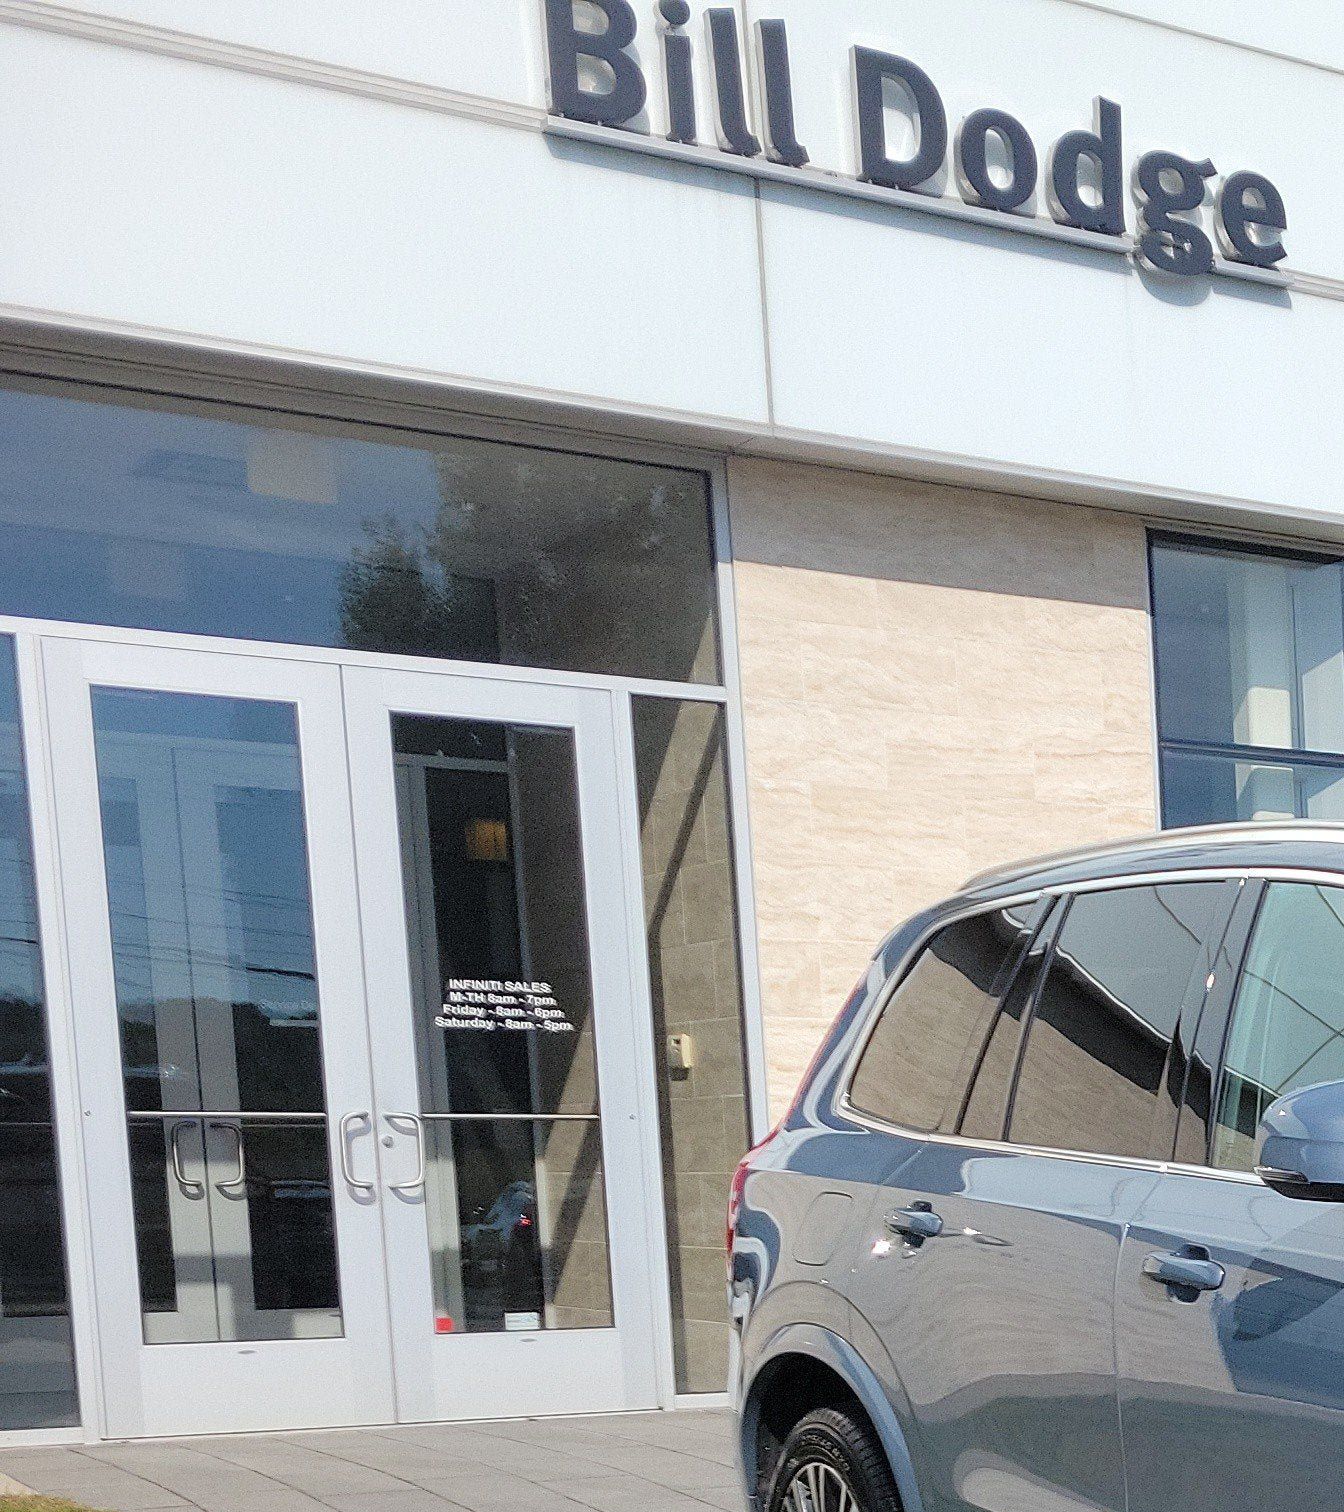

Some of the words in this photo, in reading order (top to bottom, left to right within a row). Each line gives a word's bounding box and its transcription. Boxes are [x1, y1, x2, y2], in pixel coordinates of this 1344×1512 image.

[548, 0, 810, 167] Bill
[850, 45, 1289, 276] Dodge
[449, 979, 503, 991] INFINITI
[505, 981, 552, 993] SALES
[526, 994, 557, 1006] 7pm
[443, 1003, 485, 1017] Friday
[435, 1016, 494, 1030] Saturday
